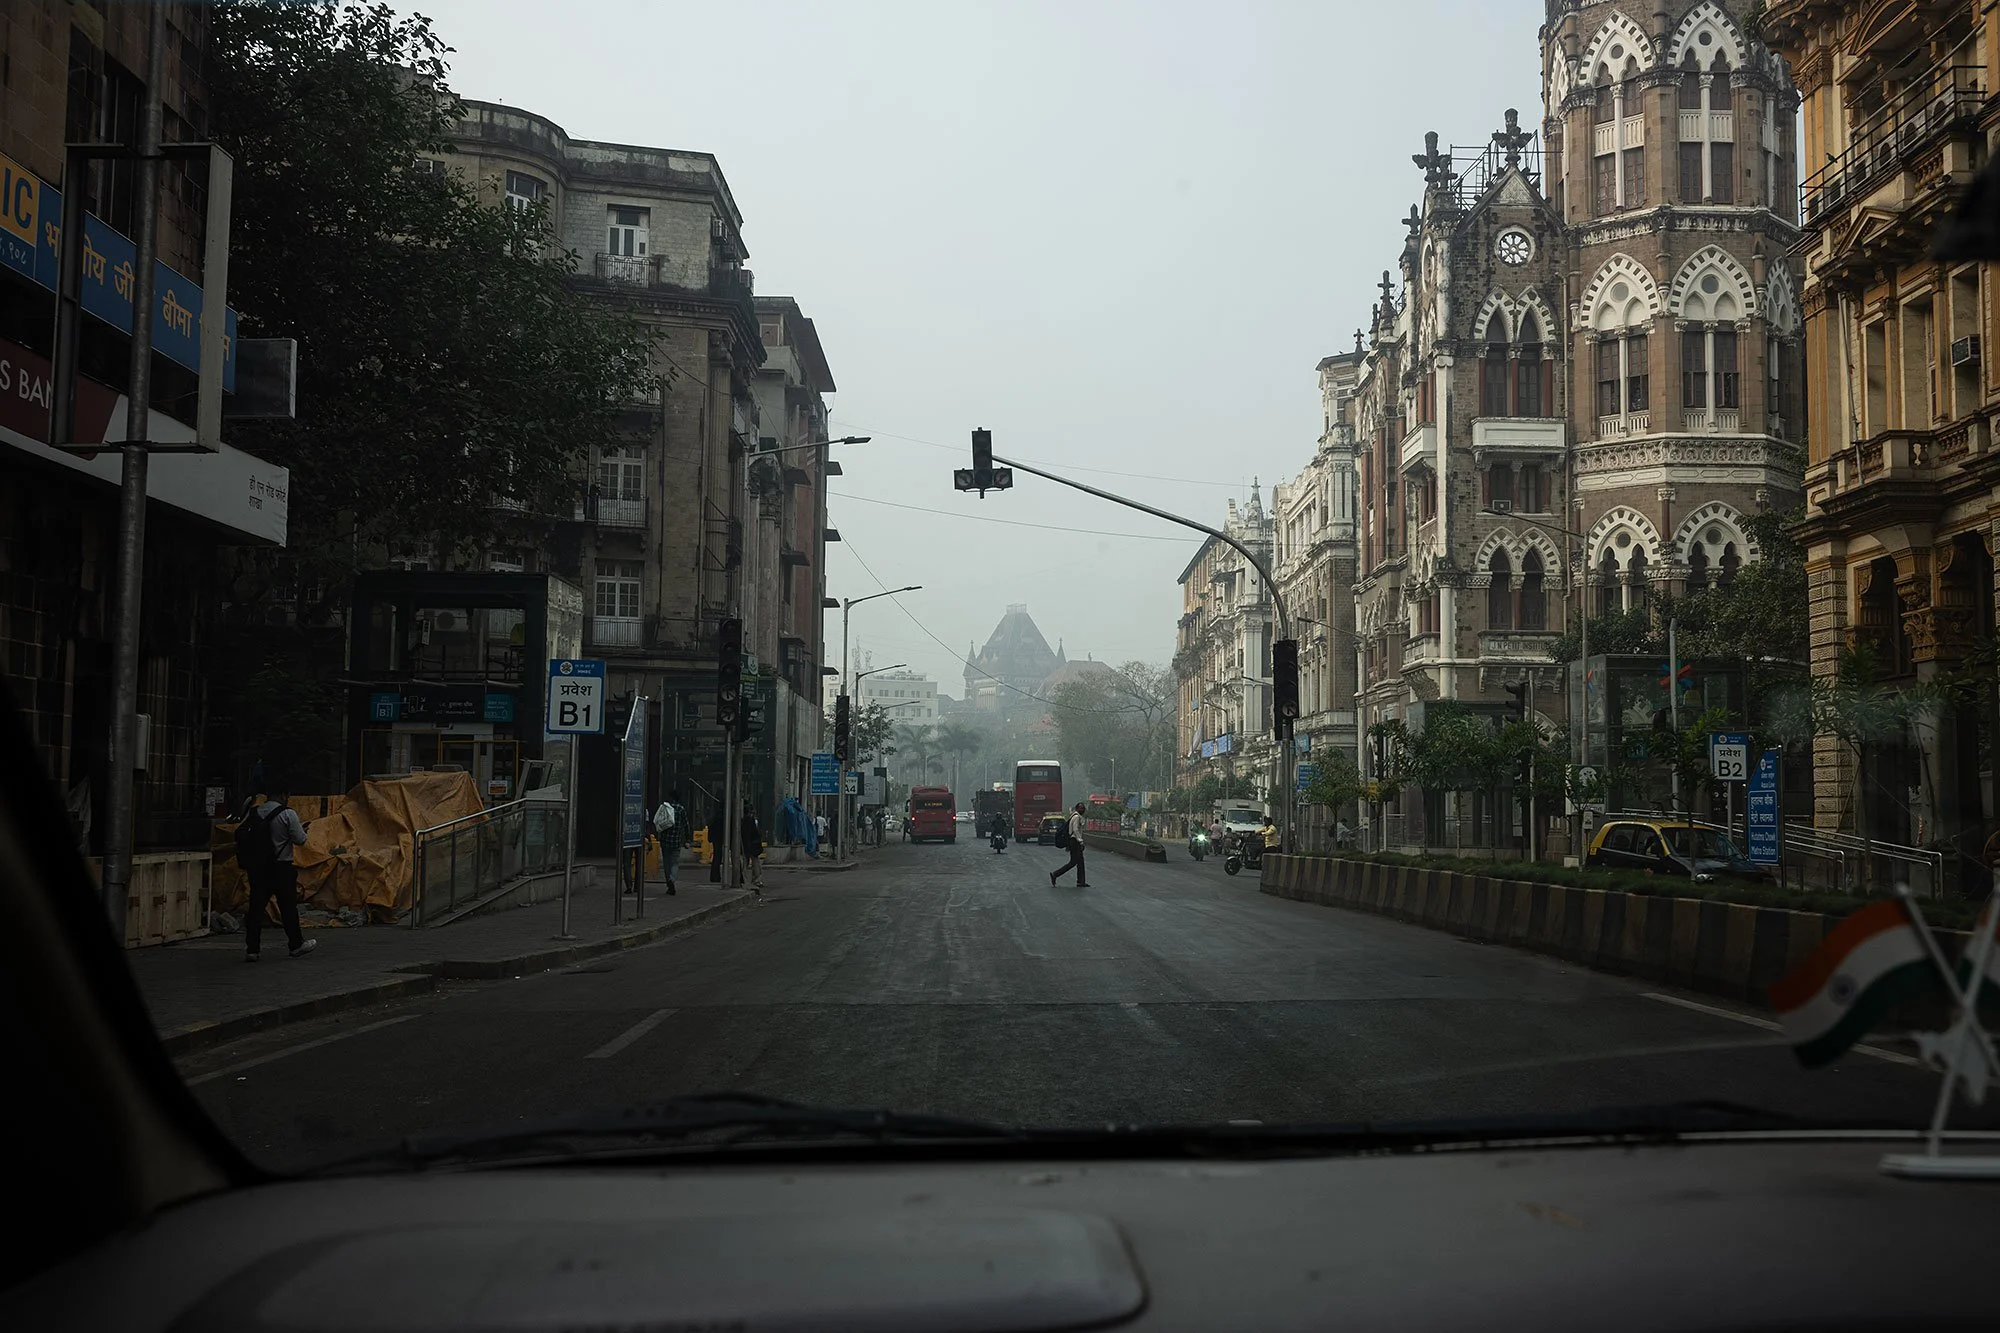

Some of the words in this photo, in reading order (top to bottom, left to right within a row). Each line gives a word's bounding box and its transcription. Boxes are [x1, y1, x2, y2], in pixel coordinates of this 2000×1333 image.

[560, 680, 593, 696] प्रवेश
[559, 701, 591, 727] B1
[1719, 747, 1742, 758] प्रवेश
[1718, 760, 1743, 778] B2
